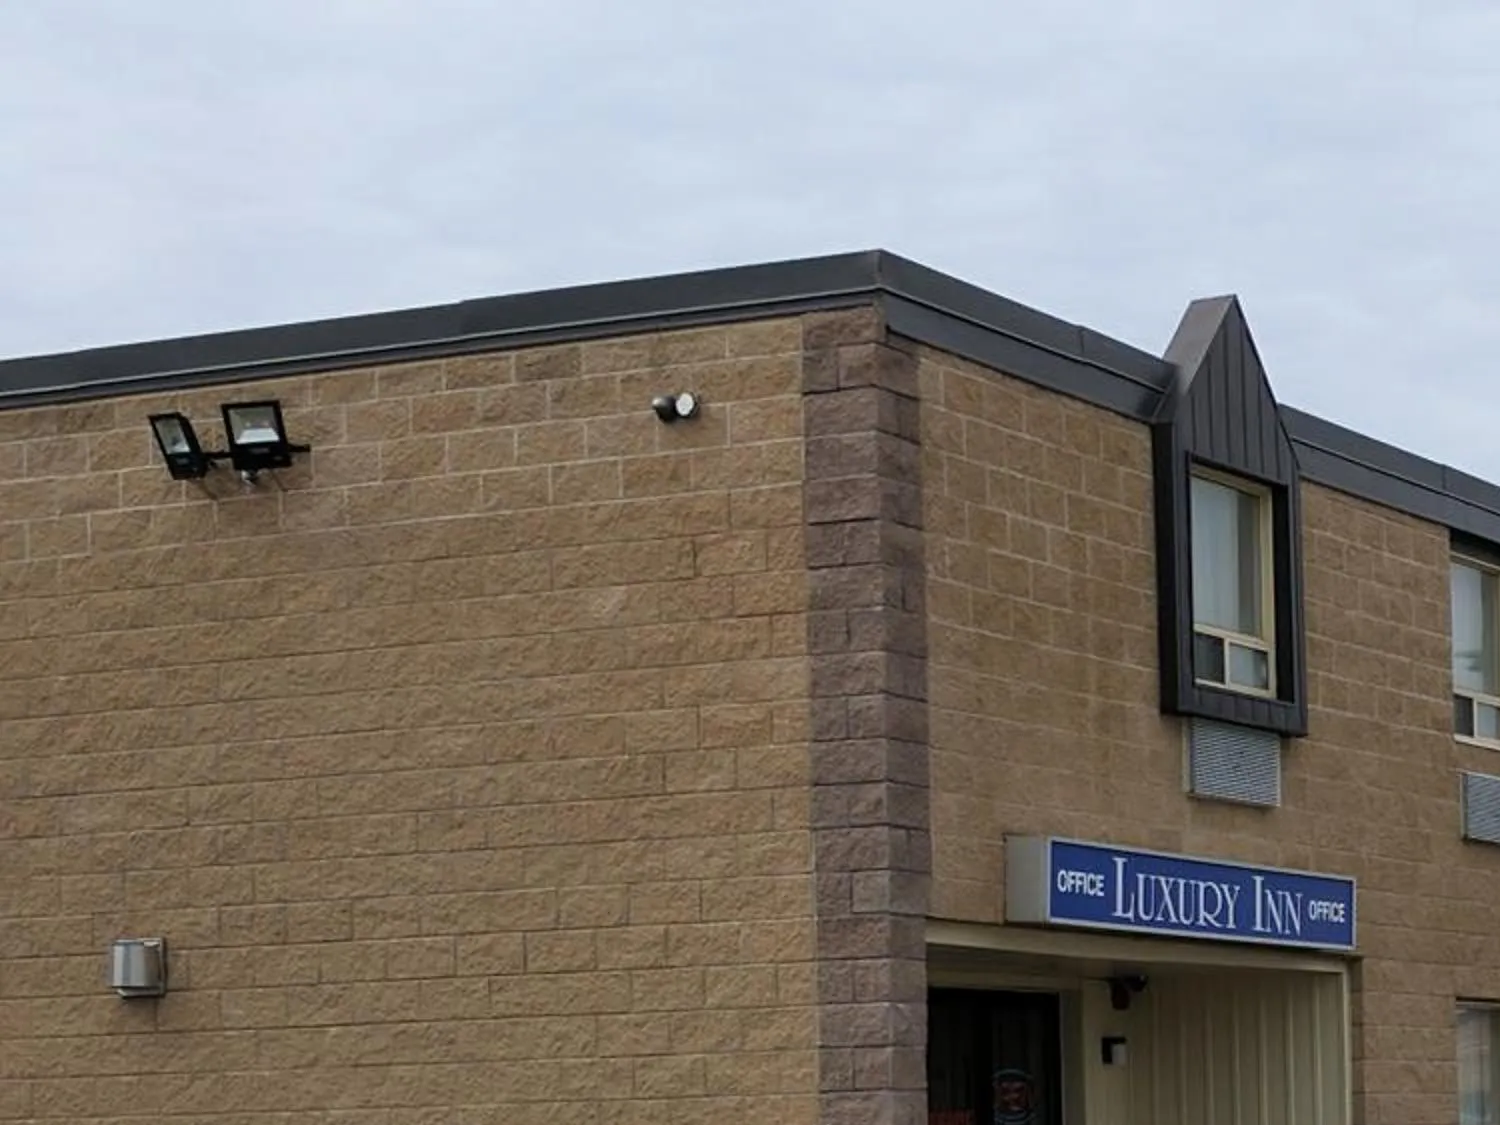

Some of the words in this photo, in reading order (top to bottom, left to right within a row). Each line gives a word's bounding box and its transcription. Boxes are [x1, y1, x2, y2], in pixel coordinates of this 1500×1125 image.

[1056, 868, 1106, 898] OFFICE
[1112, 857, 1241, 930] LUXURY
[1251, 875, 1304, 936] INN
[1308, 899, 1347, 925] OFFICE
